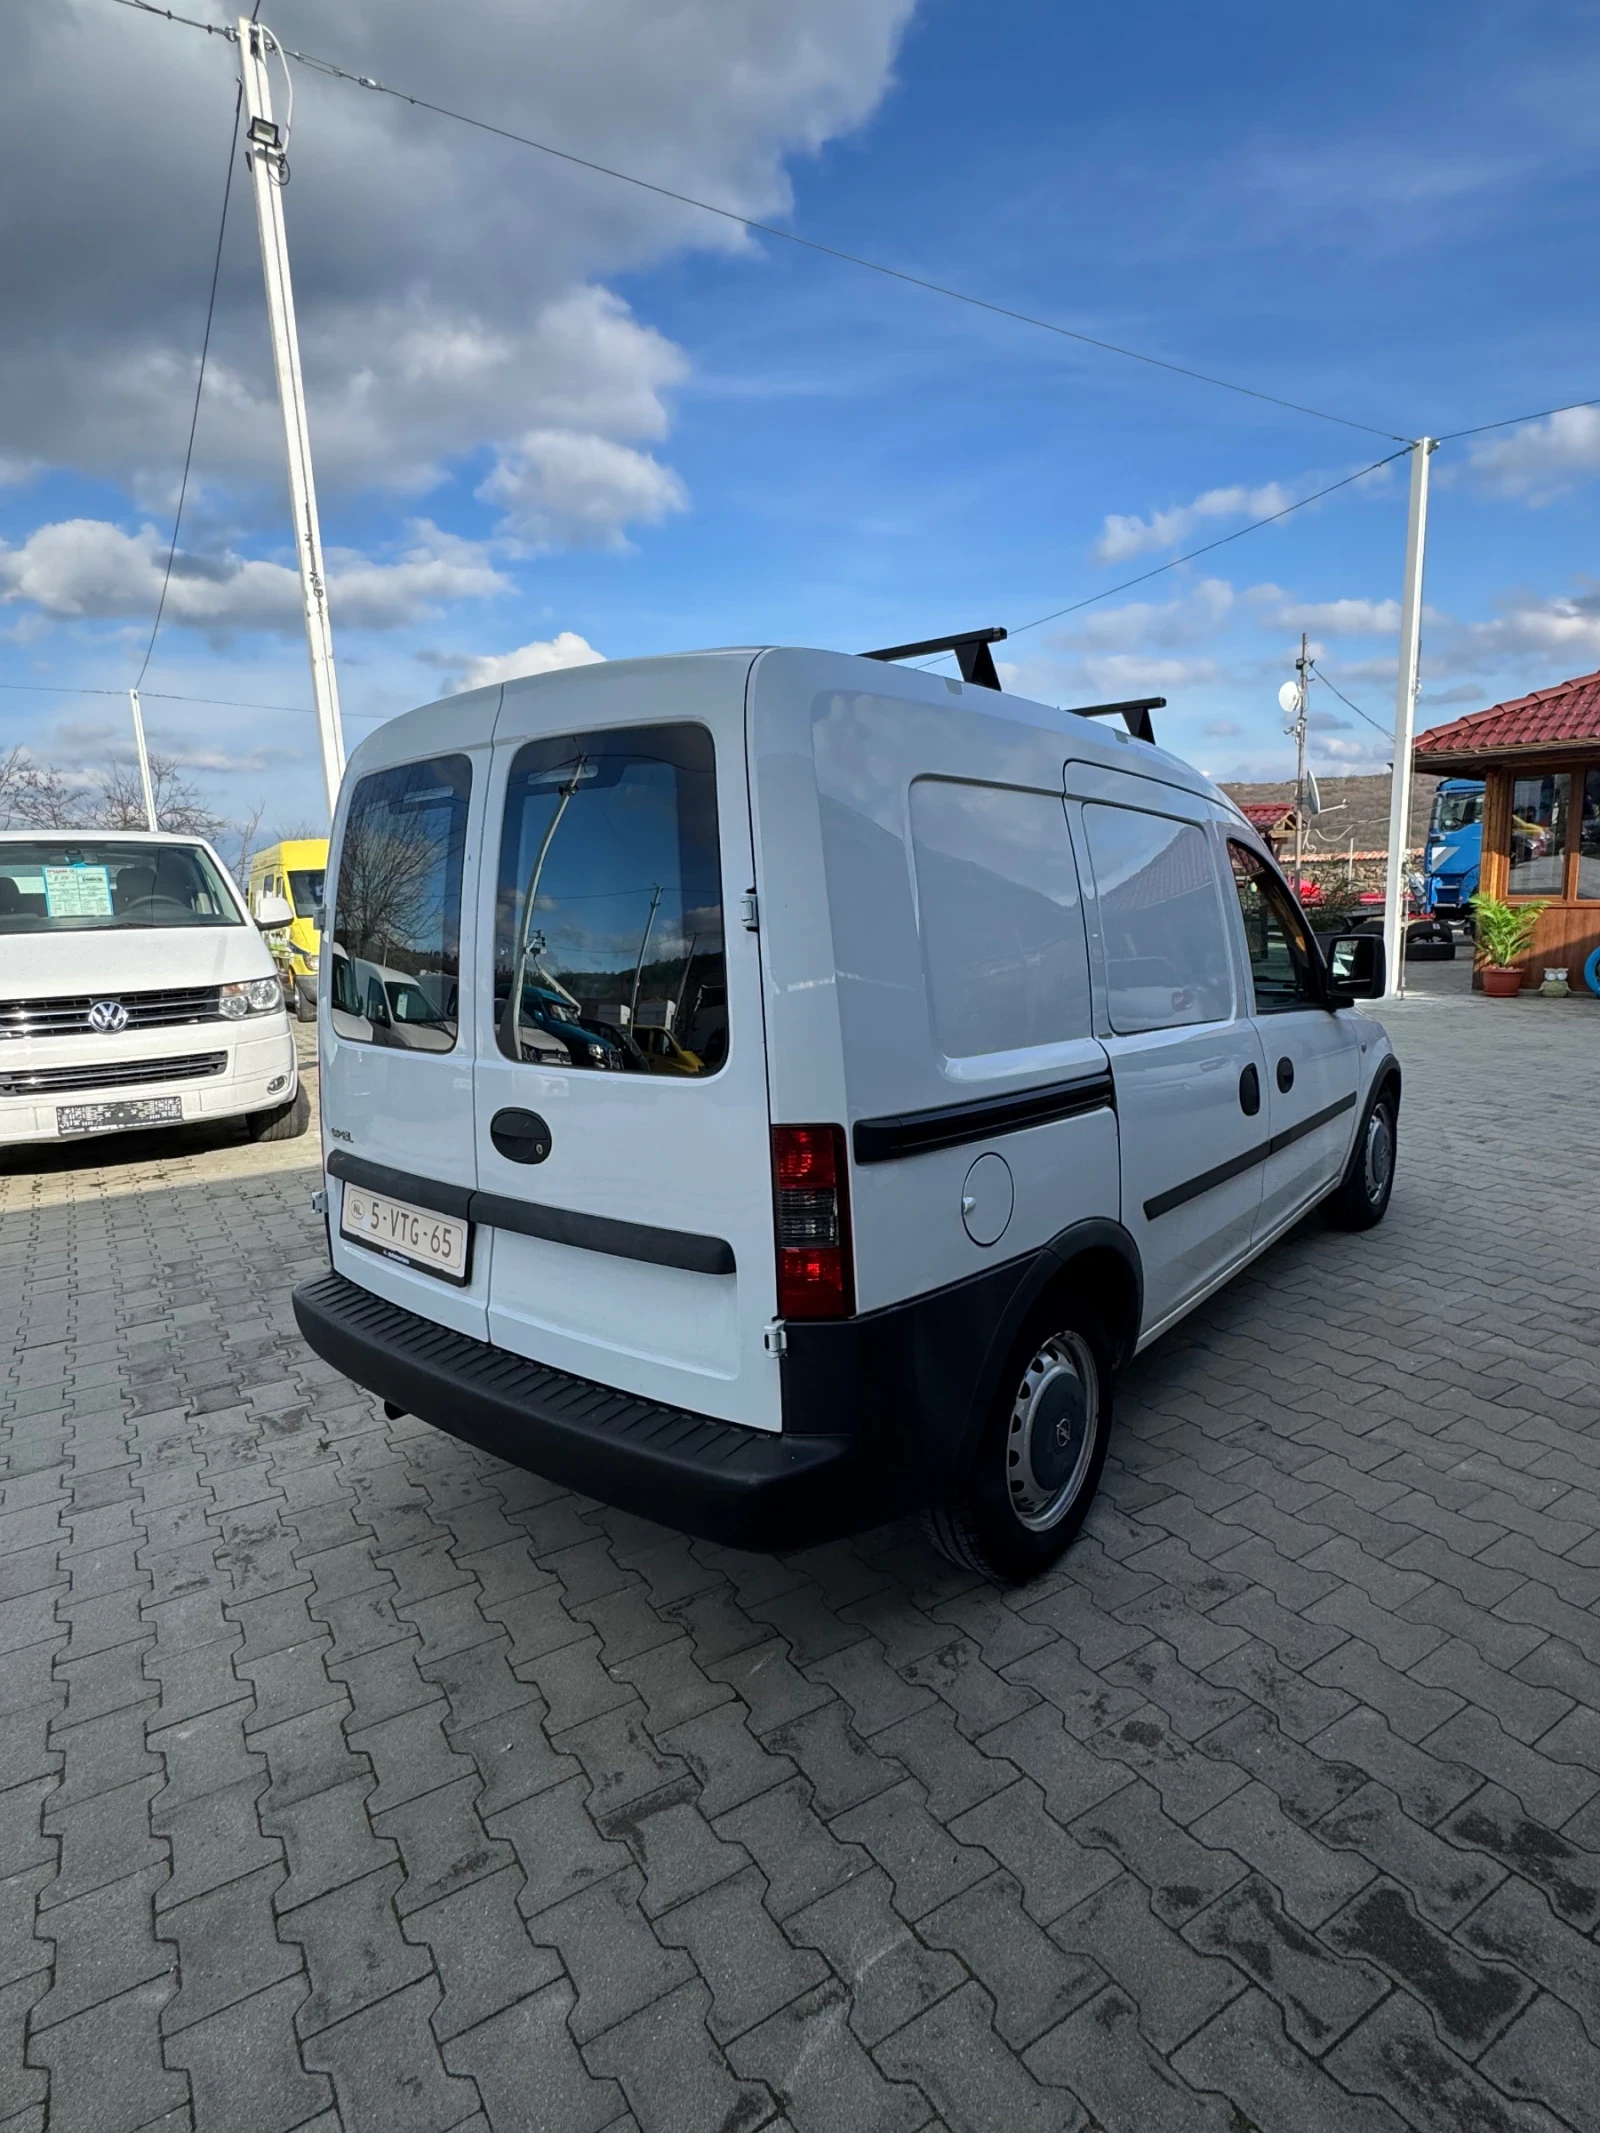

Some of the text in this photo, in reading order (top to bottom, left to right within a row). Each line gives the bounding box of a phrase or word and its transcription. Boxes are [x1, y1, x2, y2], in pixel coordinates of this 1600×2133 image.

[89, 1002, 127, 1031] VW
[353, 1203, 363, 1216] NL
[371, 1201, 452, 1258] 5-VTG-65
